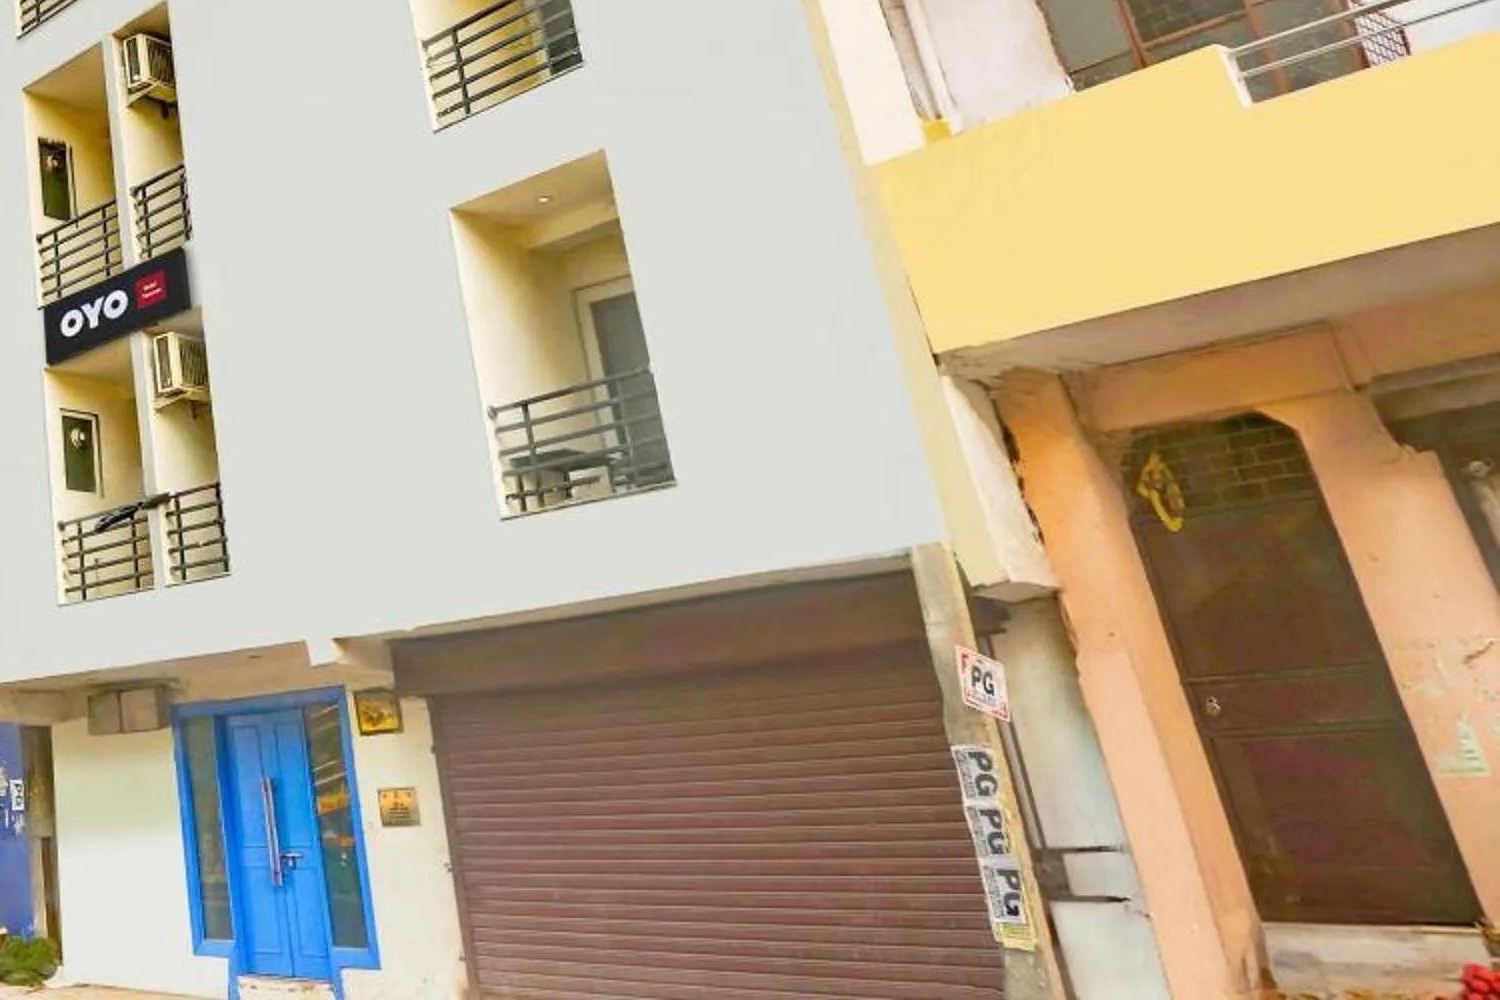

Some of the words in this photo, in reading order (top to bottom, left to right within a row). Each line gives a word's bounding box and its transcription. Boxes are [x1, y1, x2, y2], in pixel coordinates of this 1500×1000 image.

[60, 289, 129, 337] OYO
[971, 665, 995, 697] PG
[968, 751, 998, 796] PG
[979, 809, 1010, 854] PG
